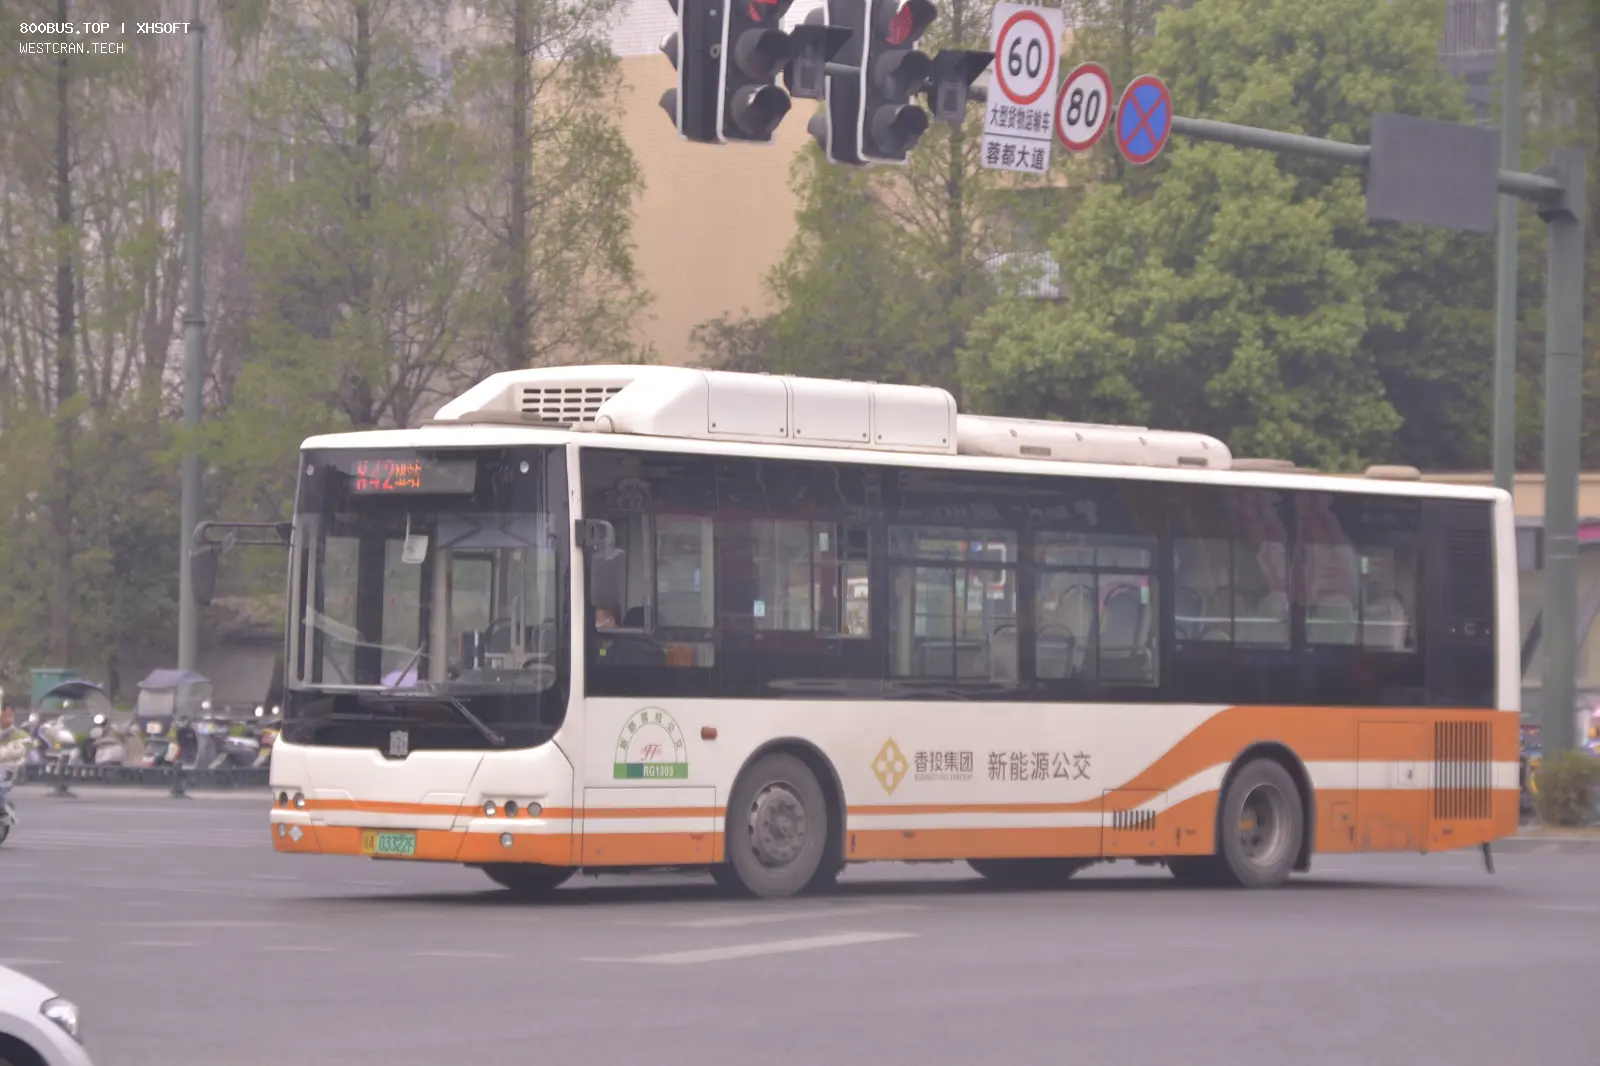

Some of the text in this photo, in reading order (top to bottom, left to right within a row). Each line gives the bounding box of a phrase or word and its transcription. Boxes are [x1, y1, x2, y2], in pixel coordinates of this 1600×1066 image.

[1008, 36, 1042, 79] 60
[989, 104, 1051, 134] 大型货物运输车
[1066, 87, 1101, 128] 80
[985, 141, 1046, 170] 蓉都大道
[643, 765, 675, 777] RG1303
[914, 751, 1092, 781] 香投集团 新能源公交
